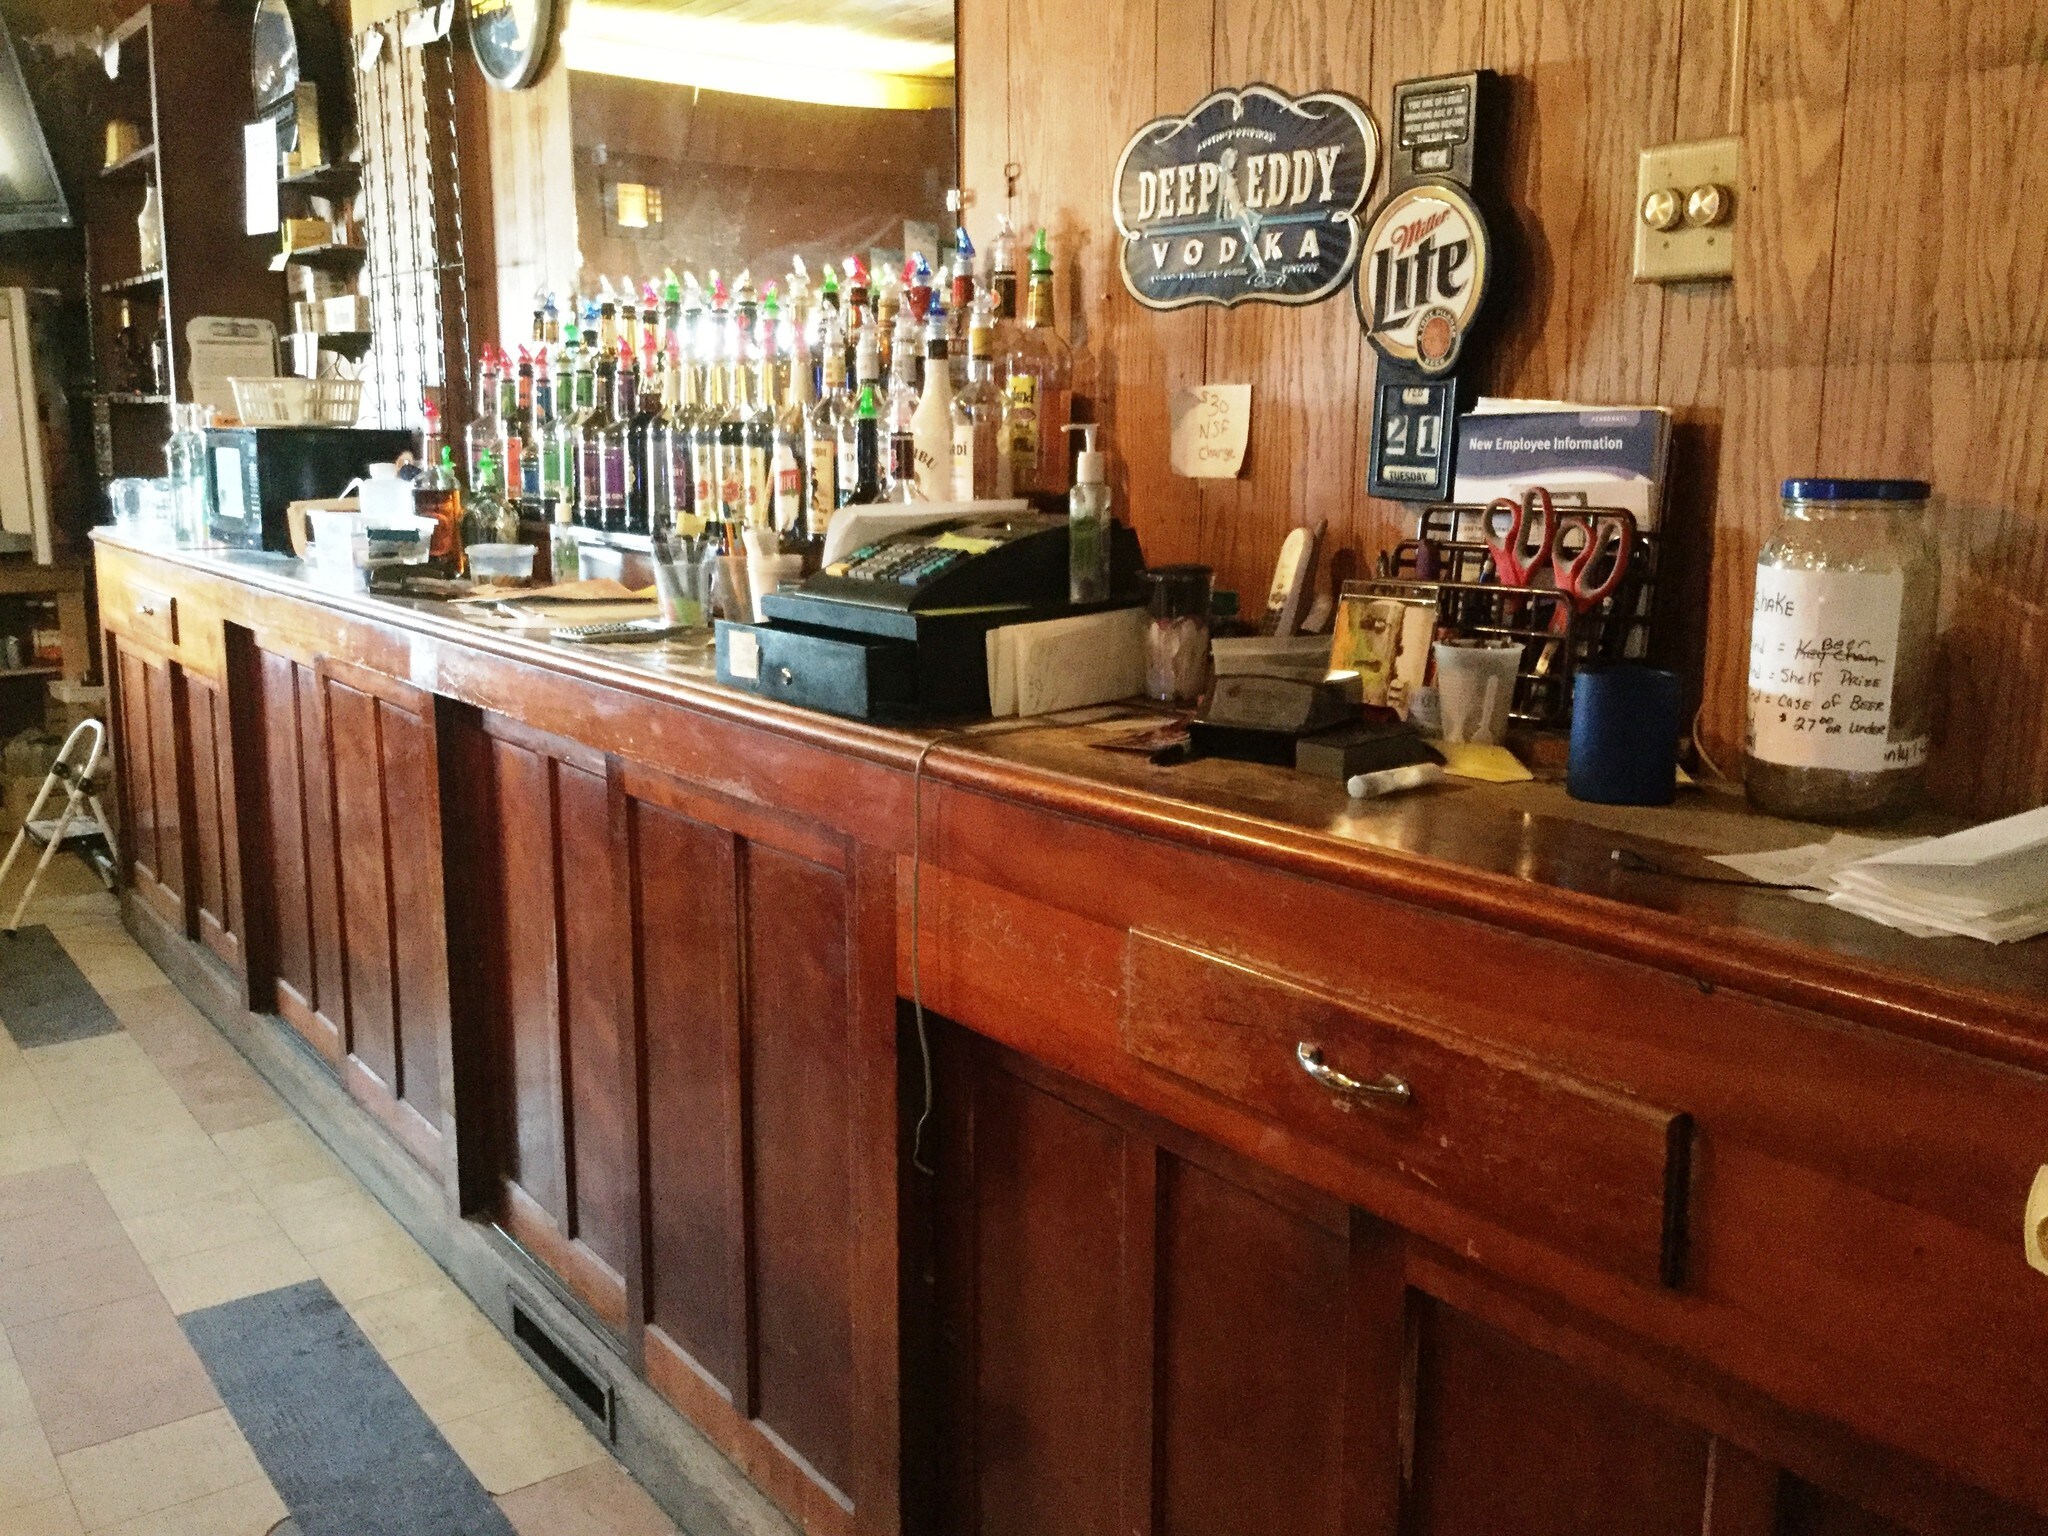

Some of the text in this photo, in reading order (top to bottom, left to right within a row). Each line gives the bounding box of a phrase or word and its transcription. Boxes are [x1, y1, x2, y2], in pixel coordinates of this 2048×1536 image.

[1137, 146, 1343, 222] DEEP EDDY
[1152, 229, 1320, 269] VODKA
[1391, 208, 1450, 257] Miller
[1371, 233, 1470, 335] Lite
[1199, 419, 1230, 439] NSF
[1388, 414, 1437, 454] 21
[1469, 436, 1623, 453] New Employee Information
[1388, 469, 1428, 481] TUESDAY
